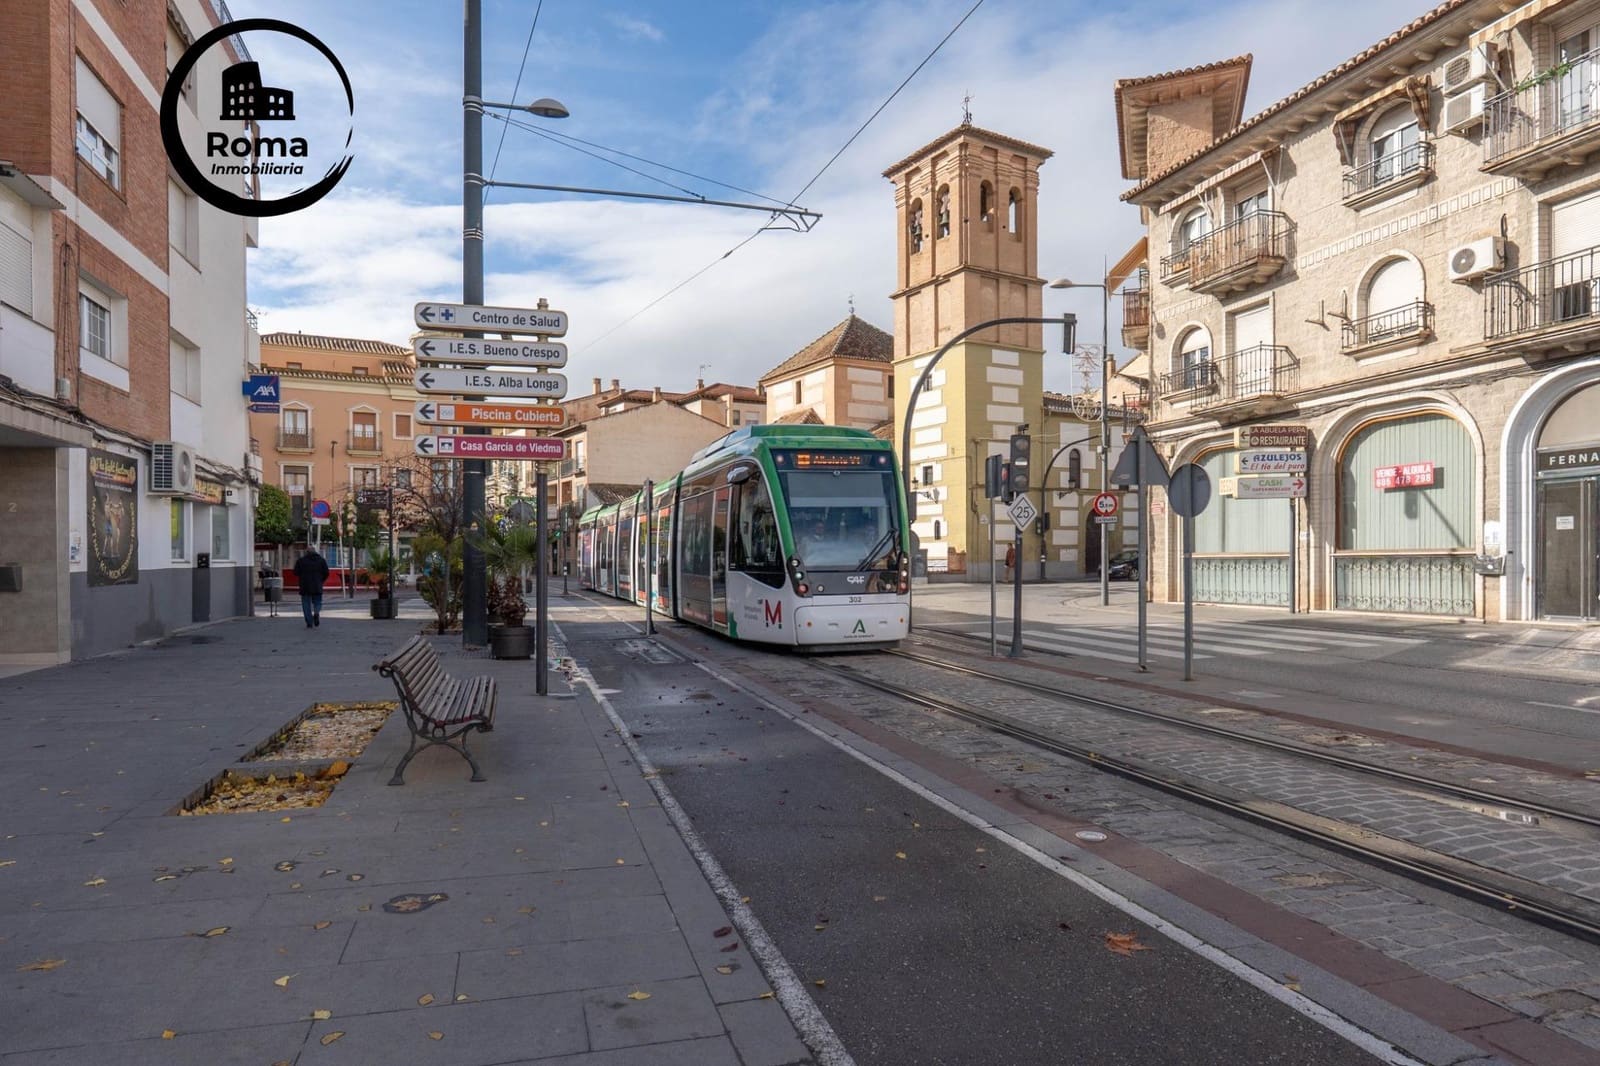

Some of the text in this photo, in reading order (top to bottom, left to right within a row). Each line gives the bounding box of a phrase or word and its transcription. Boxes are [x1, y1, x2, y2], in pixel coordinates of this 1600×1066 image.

[472, 311, 560, 328] Centro de Salud
[449, 342, 560, 360] I.E.S. Bueno Crespo
[465, 375, 559, 391] I.E.S. Alba Longa
[254, 385, 276, 397] AXA
[471, 407, 560, 422] Piscina Cubierta
[460, 440, 561, 454] Casa García de Viedma
[1260, 436, 1306, 446] RESTAURANTE
[1253, 453, 1302, 462] AZULEJOS
[1549, 452, 1600, 466] FERNA
[1274, 462, 1286, 470] del
[1287, 463, 1305, 471] puro
[1402, 464, 1431, 475] ALQUILA
[8, 502, 17, 512] 2
[1016, 506, 1030, 519] 25
[764, 599, 782, 627] M
